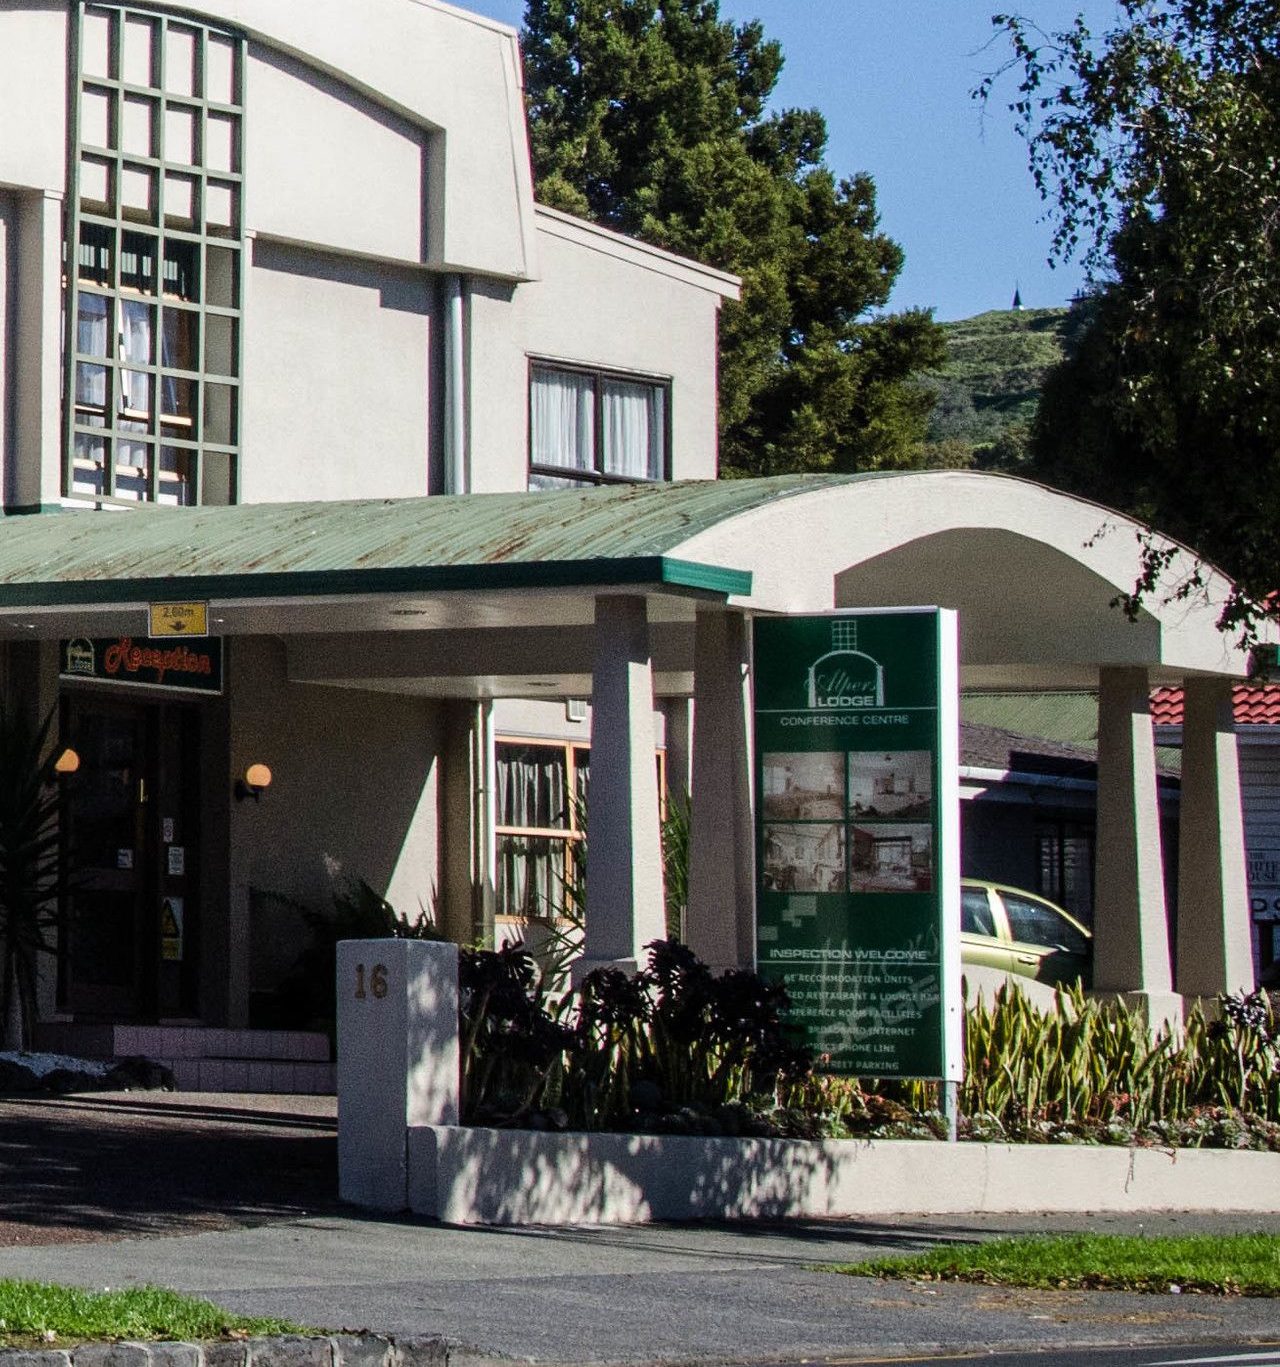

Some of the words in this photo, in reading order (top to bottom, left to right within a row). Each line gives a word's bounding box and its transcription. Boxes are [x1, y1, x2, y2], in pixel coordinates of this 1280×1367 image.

[818, 696, 874, 707] LODGE
[780, 715, 859, 726] CONFERENCE
[862, 714, 909, 725] CENTRE
[770, 949, 852, 959] INSPECTION
[854, 950, 927, 960] WELCOME
[354, 963, 388, 999] 16
